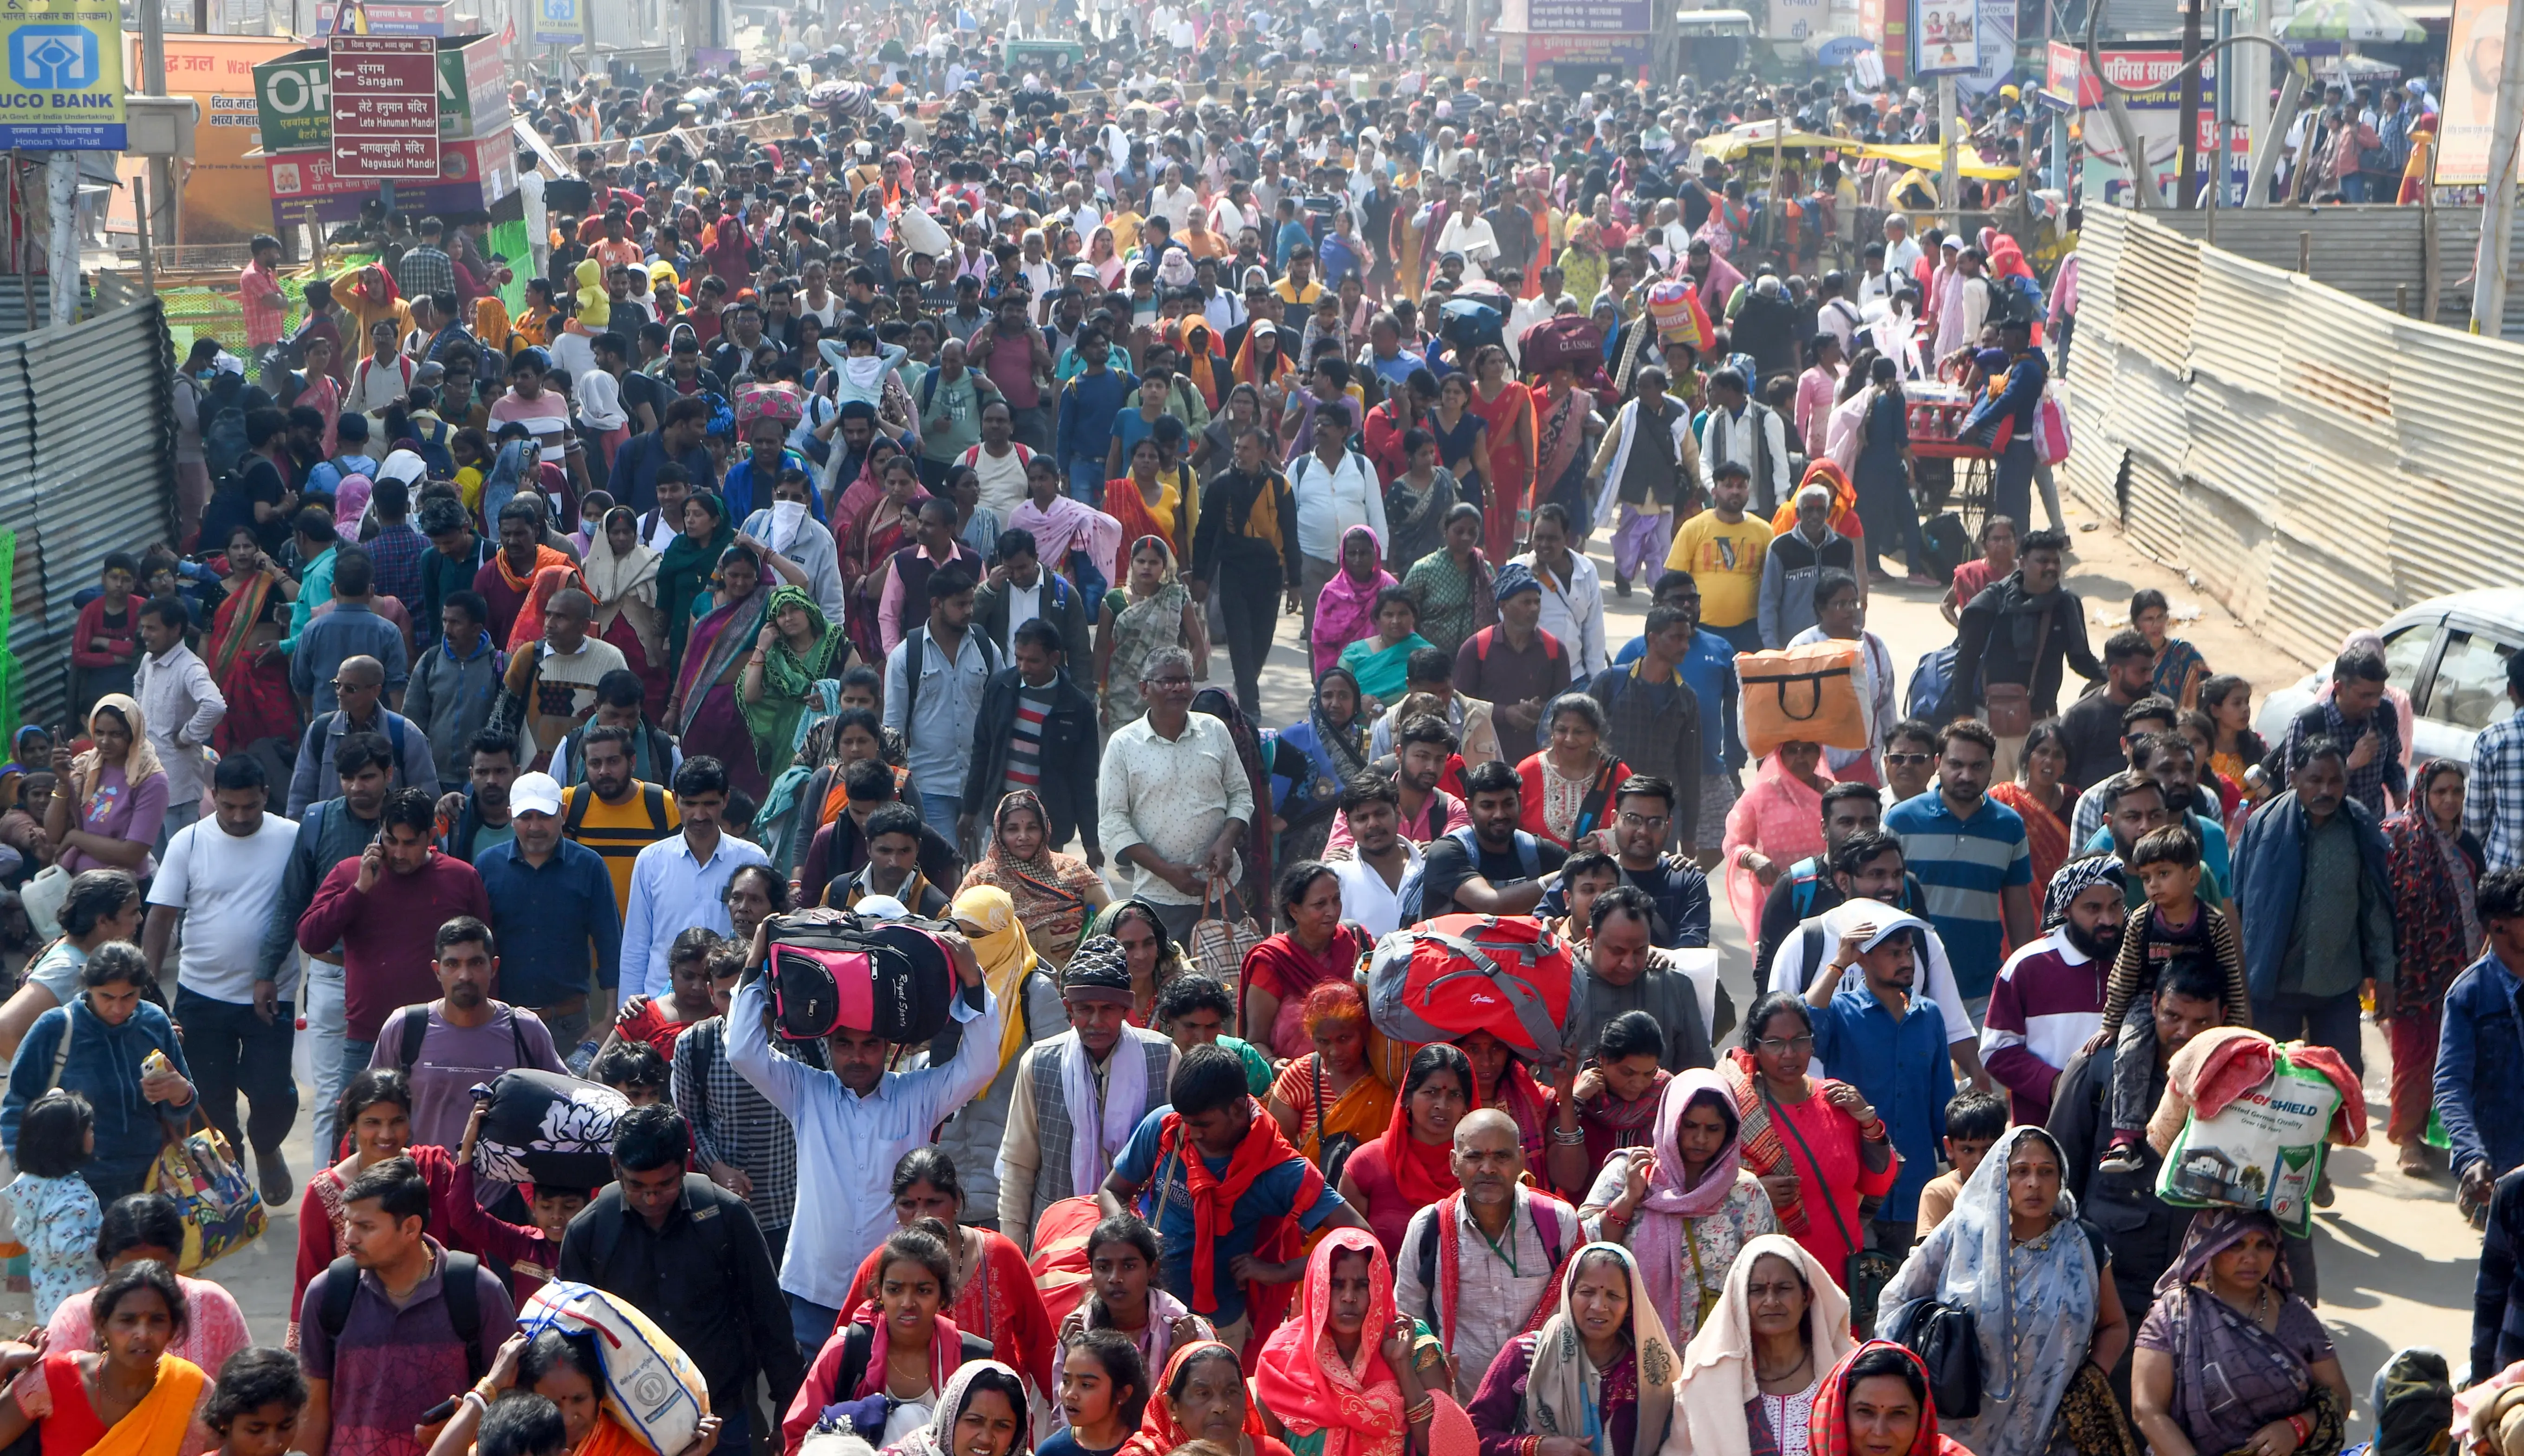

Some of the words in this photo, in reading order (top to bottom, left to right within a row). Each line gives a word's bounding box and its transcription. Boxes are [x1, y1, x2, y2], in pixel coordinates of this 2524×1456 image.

[62, 12, 74, 20] का
[182, 55, 215, 71] जल
[357, 60, 385, 74] संगम
[358, 76, 403, 88] Sangam
[0, 94, 45, 108] UCO
[52, 94, 114, 108] BANK
[212, 95, 233, 109] दिव्य
[358, 98, 372, 113] लेटे
[377, 102, 403, 116] हनुमान
[407, 98, 428, 113] मंदिर
[211, 115, 233, 125] भव्य
[359, 117, 375, 128] Lete
[377, 117, 409, 128] Hanuman
[411, 117, 435, 128] Mandir
[359, 140, 401, 157] नागवासुकी
[404, 140, 425, 154] मंदिर
[361, 158, 403, 170] Nagvasuki
[407, 158, 435, 169] Mandir
[1560, 339, 1596, 352] CLASSIC
[896, 974, 908, 1001] Royal
[2277, 1118, 2303, 1130] Quality
